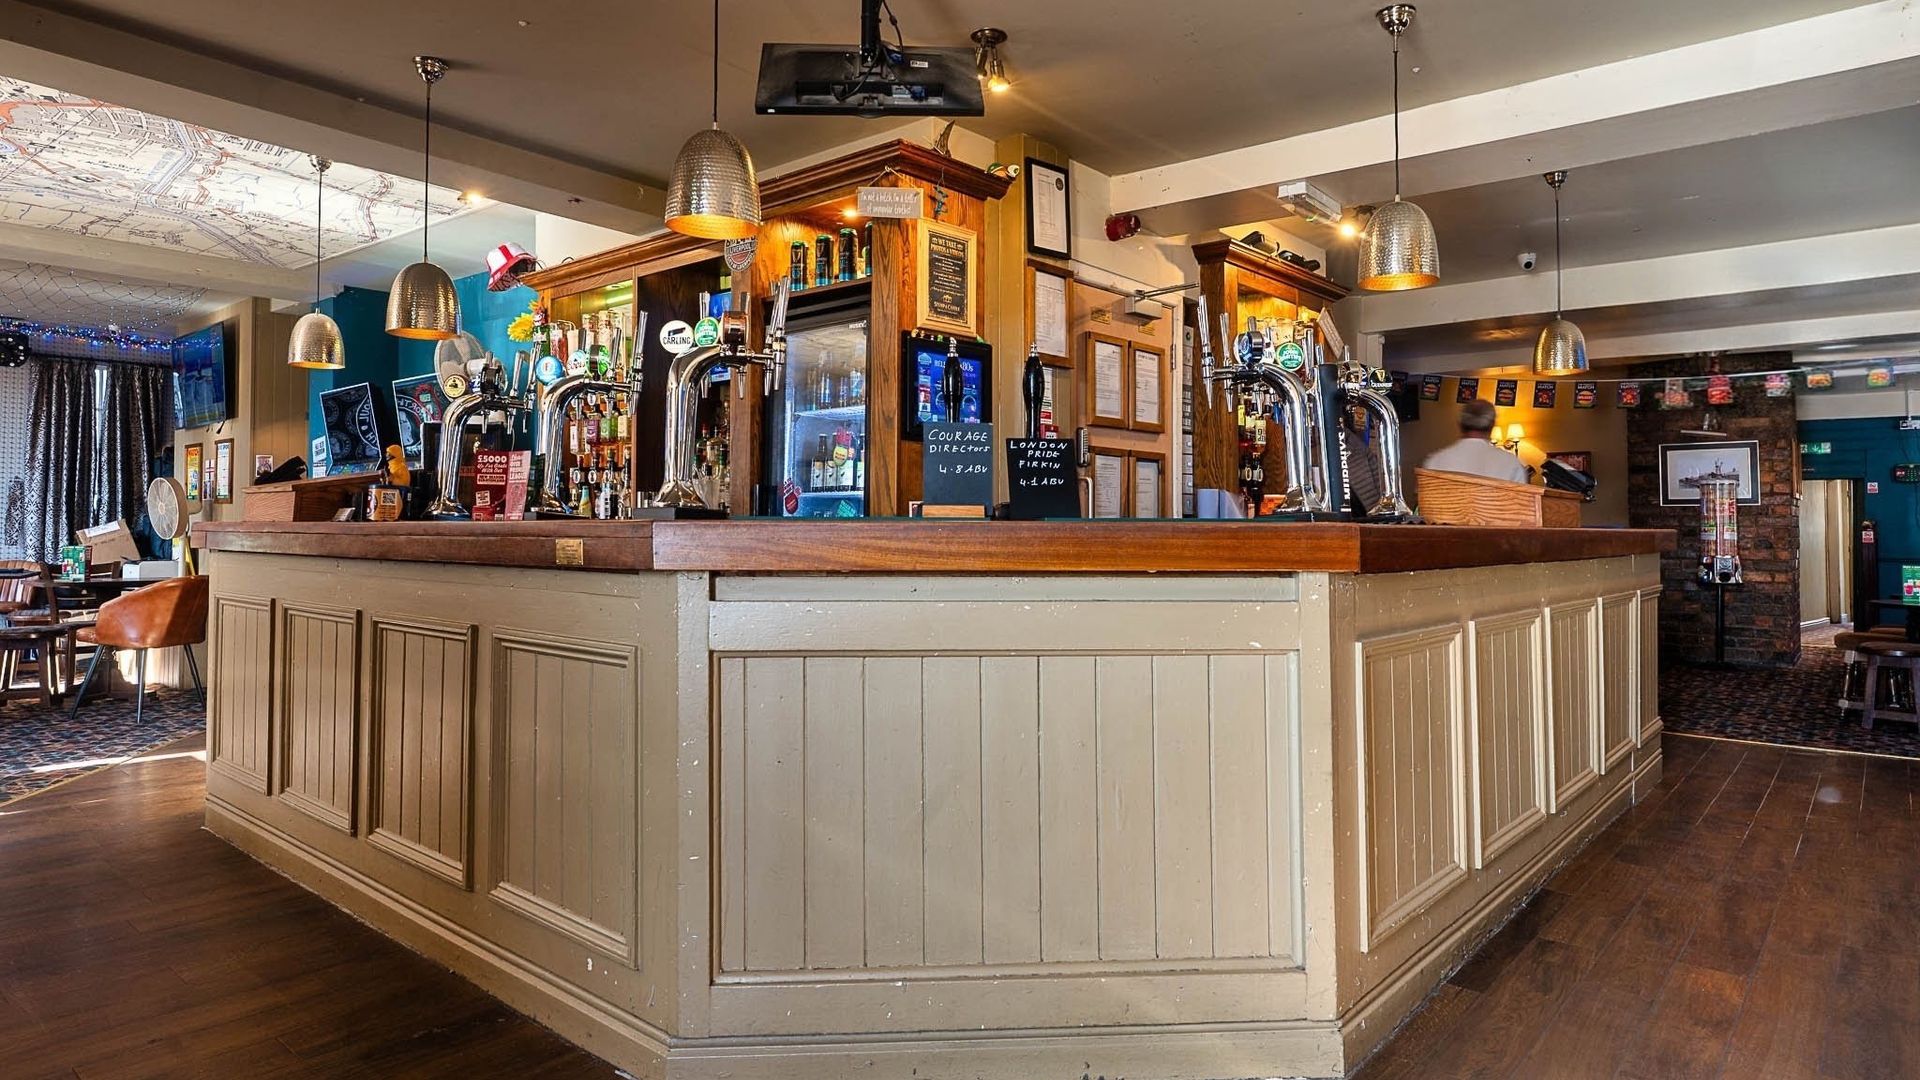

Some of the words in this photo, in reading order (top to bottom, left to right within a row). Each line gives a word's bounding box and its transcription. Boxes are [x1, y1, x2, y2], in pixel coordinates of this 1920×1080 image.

[662, 336, 691, 345] CARLING
[928, 429, 988, 442] COURAGE
[1010, 440, 1068, 450] LONDON
[477, 454, 507, 463] £5000
[1027, 450, 1060, 458] PRIDE
[1019, 460, 1061, 469] FIRKIN
